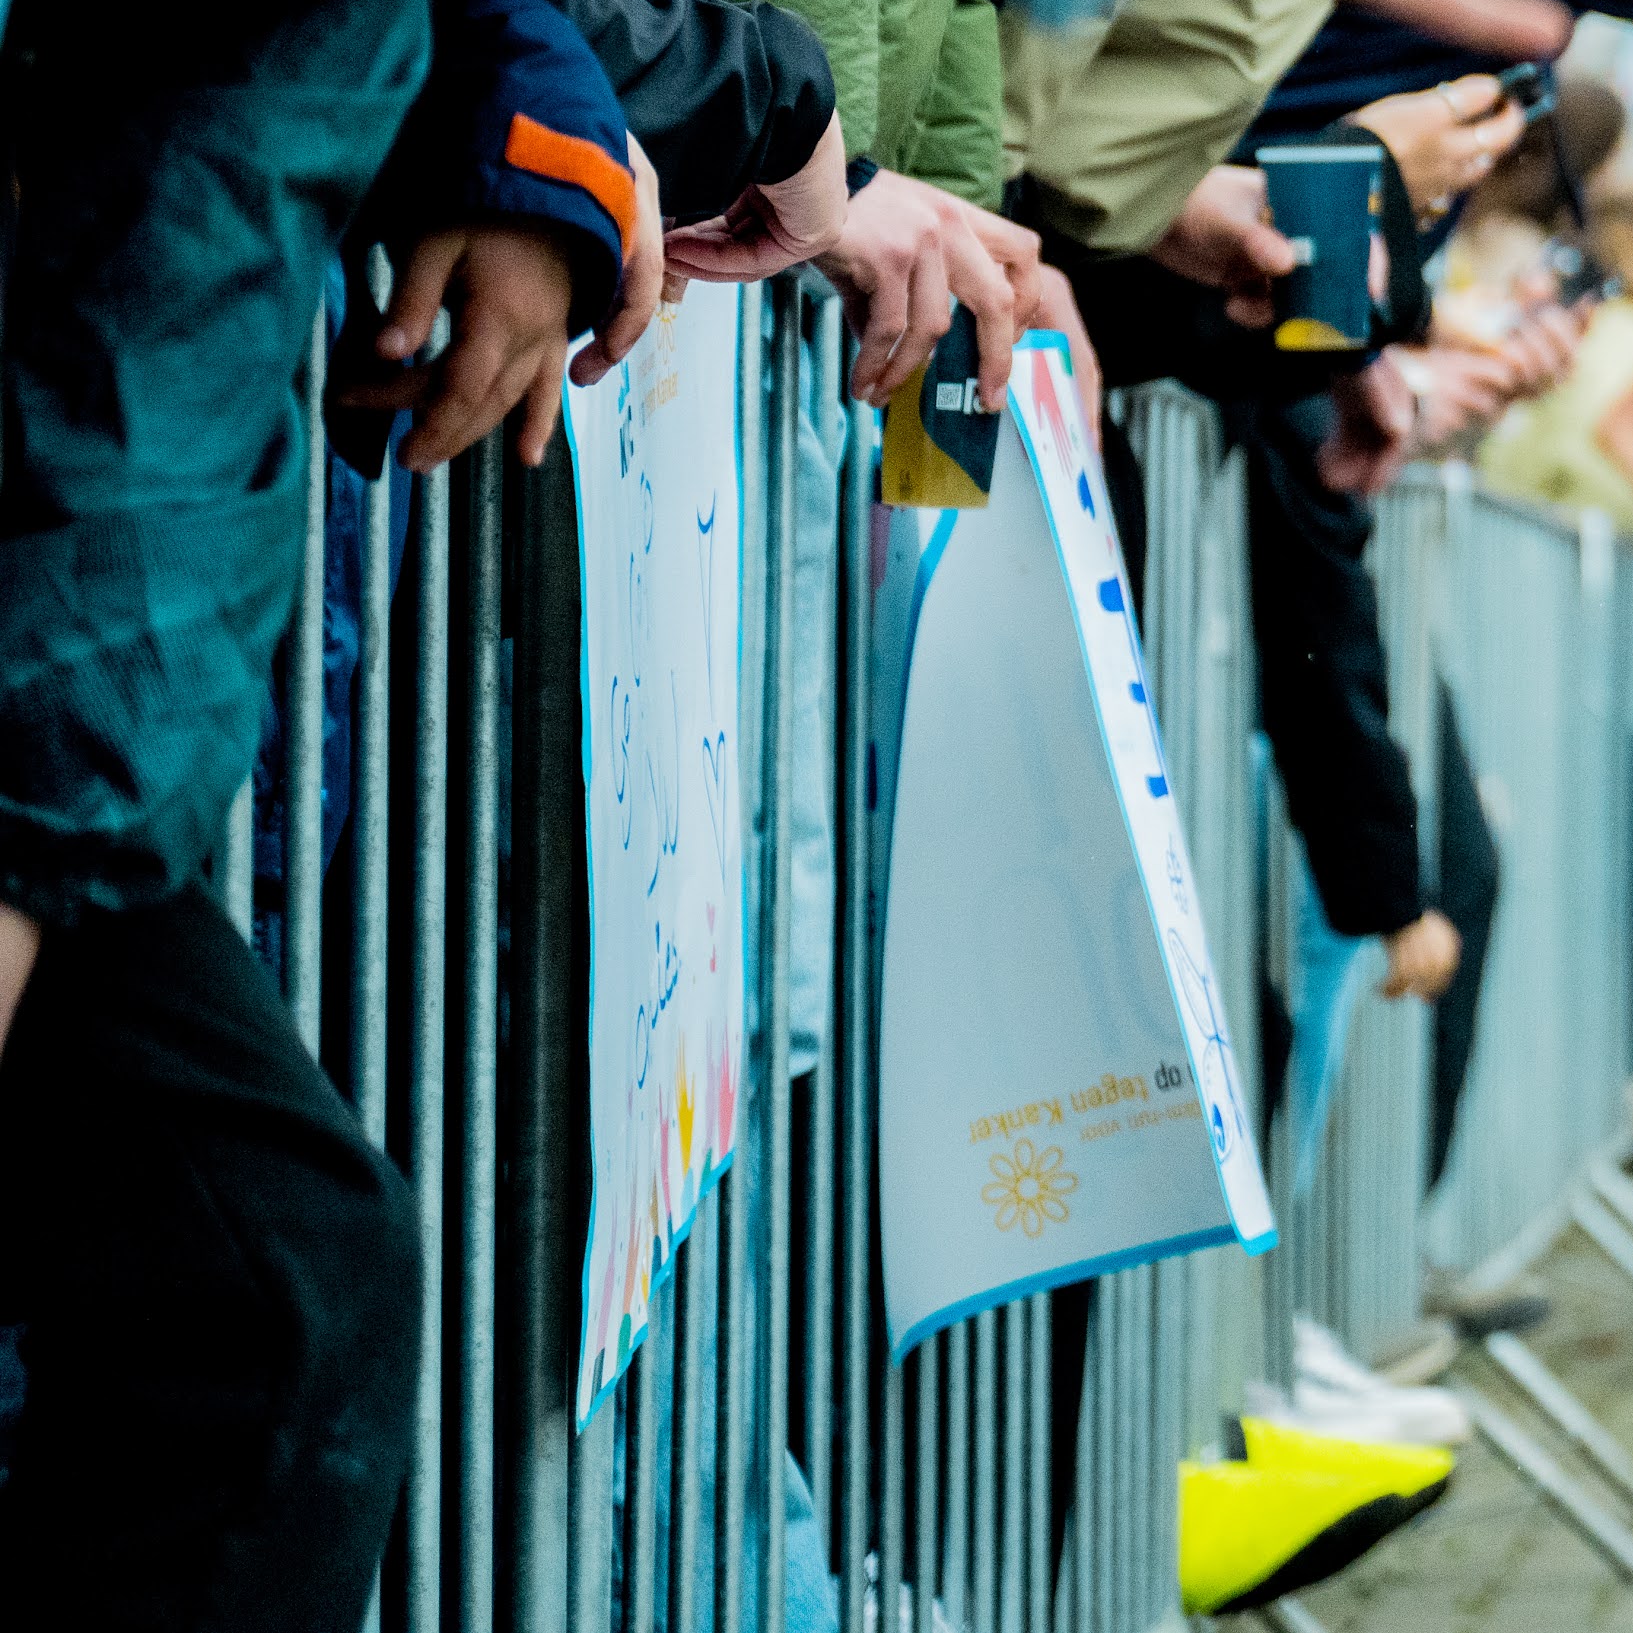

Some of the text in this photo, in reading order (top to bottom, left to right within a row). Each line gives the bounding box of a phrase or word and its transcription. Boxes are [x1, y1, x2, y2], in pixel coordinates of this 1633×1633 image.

[1070, 1073, 1151, 1114] tegen
[1155, 1061, 1182, 1091] op
[969, 1098, 1065, 1144] Kanker
